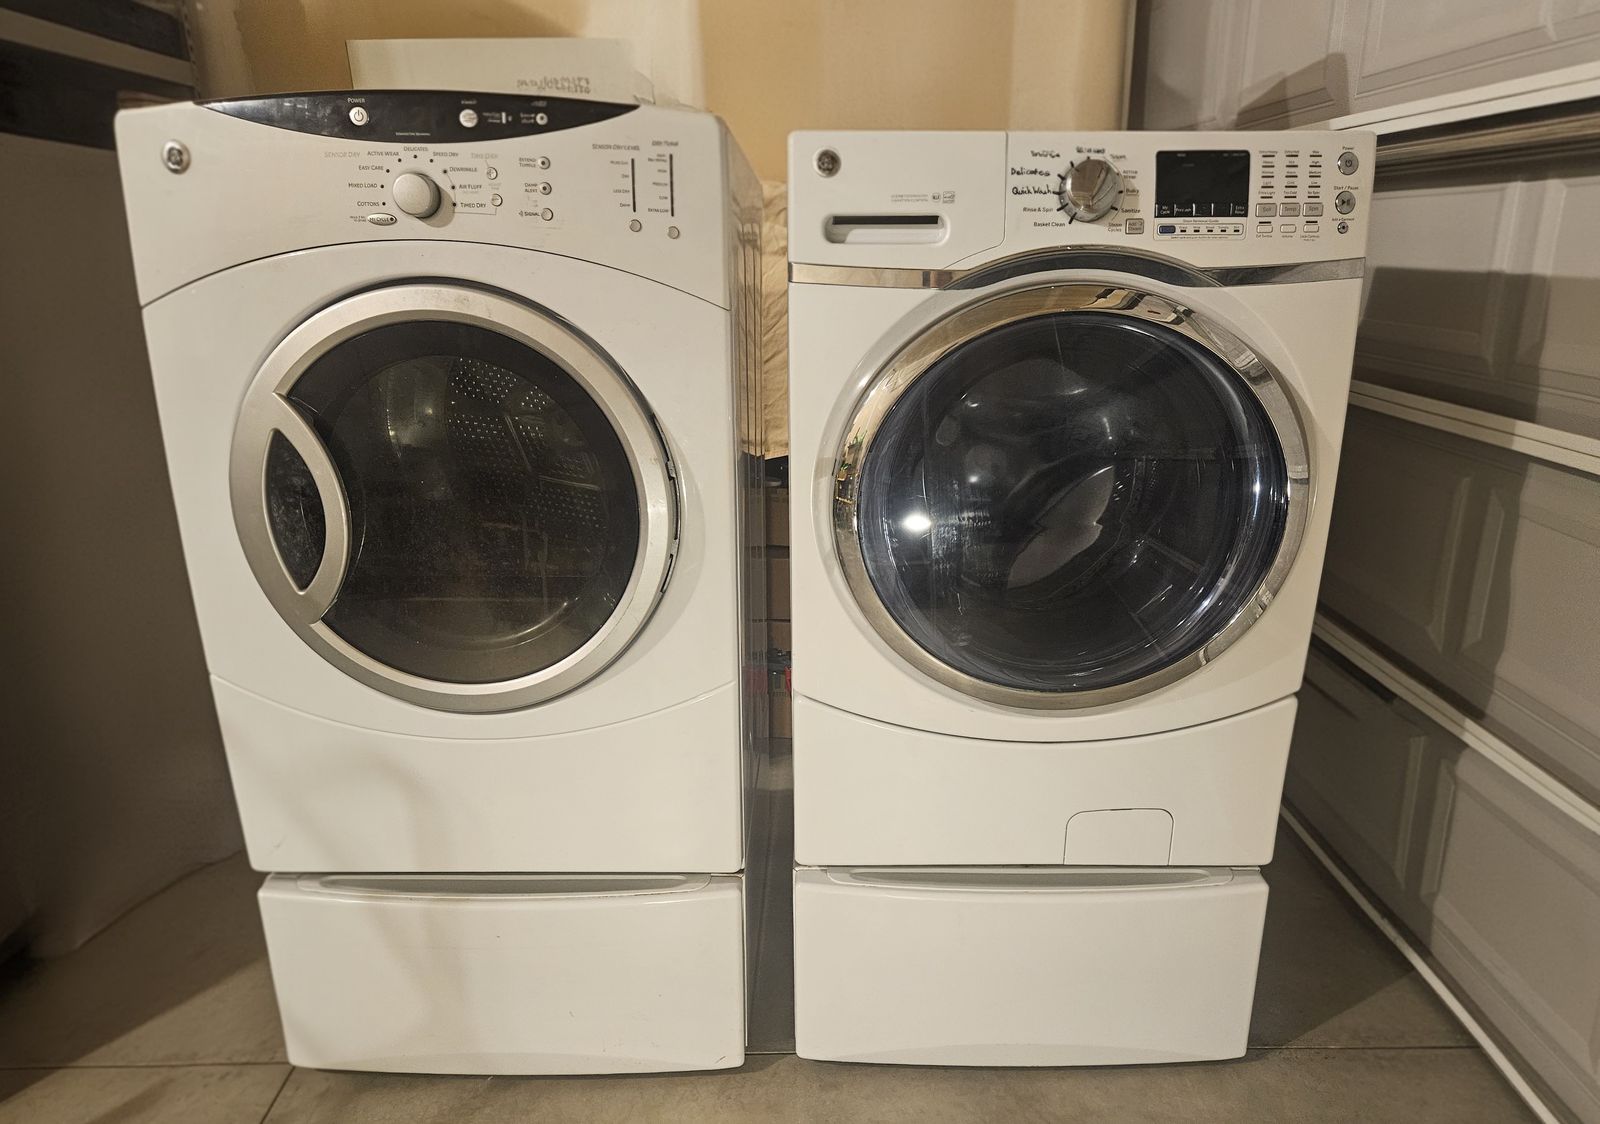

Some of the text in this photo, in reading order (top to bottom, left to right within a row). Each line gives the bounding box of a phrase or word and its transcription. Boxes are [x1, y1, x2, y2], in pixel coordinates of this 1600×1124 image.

[1010, 168, 1051, 177] Delicates
[1012, 184, 1052, 196] Quick Wash
